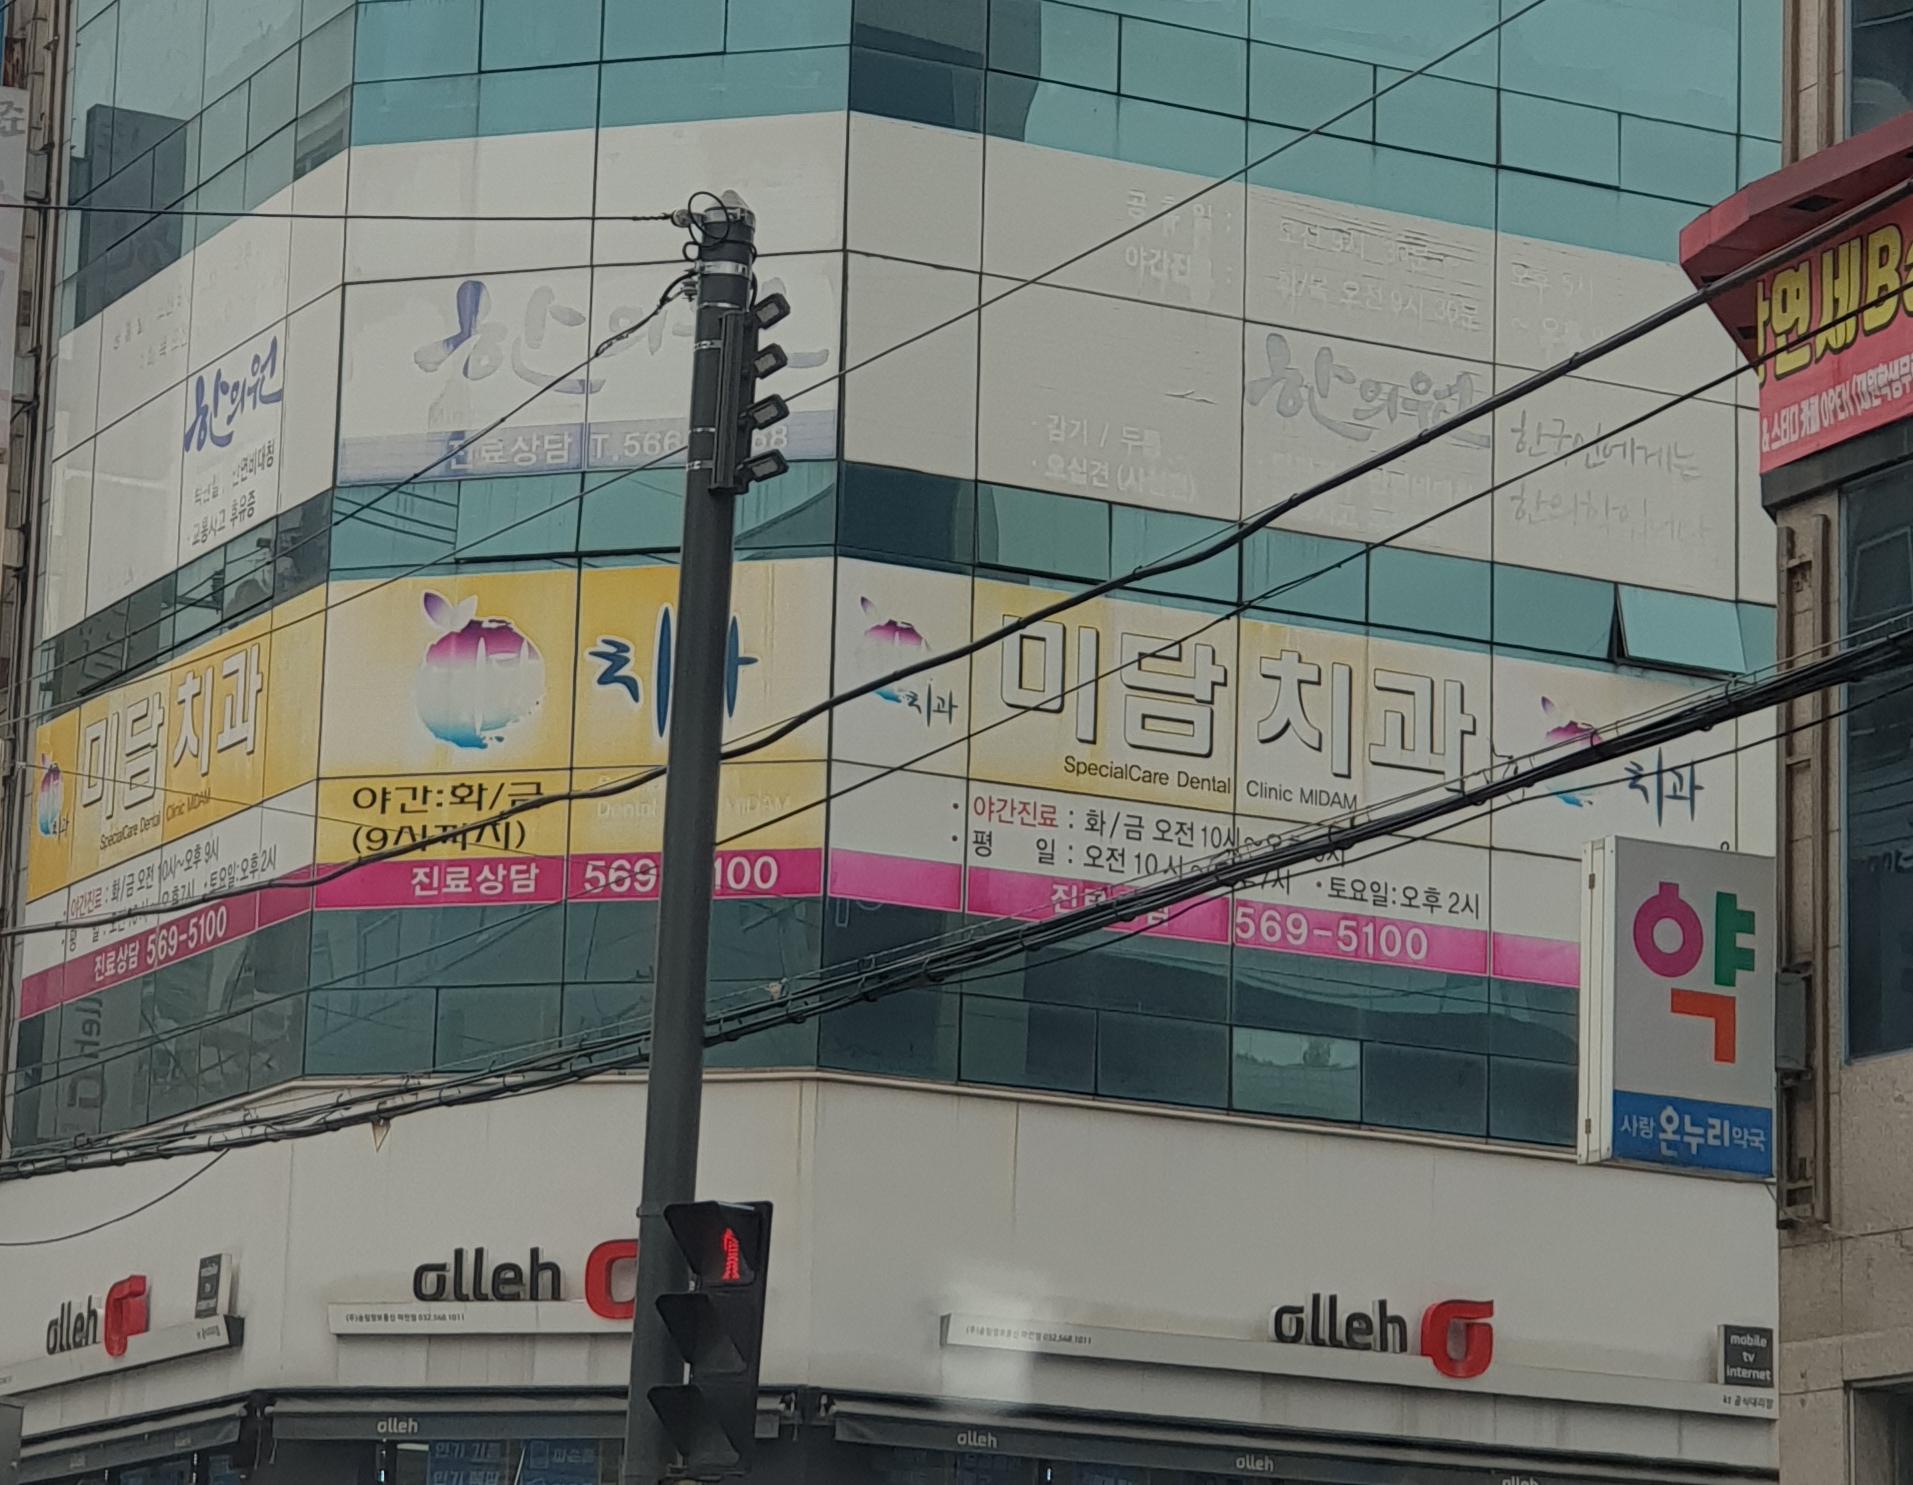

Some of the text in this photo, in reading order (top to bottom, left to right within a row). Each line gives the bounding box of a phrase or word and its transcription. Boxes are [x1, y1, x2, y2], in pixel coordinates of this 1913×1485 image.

[1757, 223, 1913, 387] 연세B
[448, 430, 572, 471] 진료상담
[82, 642, 264, 820] 미담치과
[1001, 614, 1477, 796] 미담치과
[1063, 754, 1358, 812] SpecialCare Dental Clinic MIDAM
[1152, 818, 1195, 850] 오전
[411, 855, 778, 897] 진료상담 569100
[1083, 843, 1126, 876] 오전
[1448, 890, 1480, 920] 2시
[94, 904, 227, 982] 진료상담 569-5100
[1235, 906, 1428, 962] 569-5100
[1633, 881, 1755, 1064] 약
[1730, 1334, 1767, 1347] mobile
[1742, 1351, 1755, 1362] tv
[1726, 1365, 1771, 1380] internet
